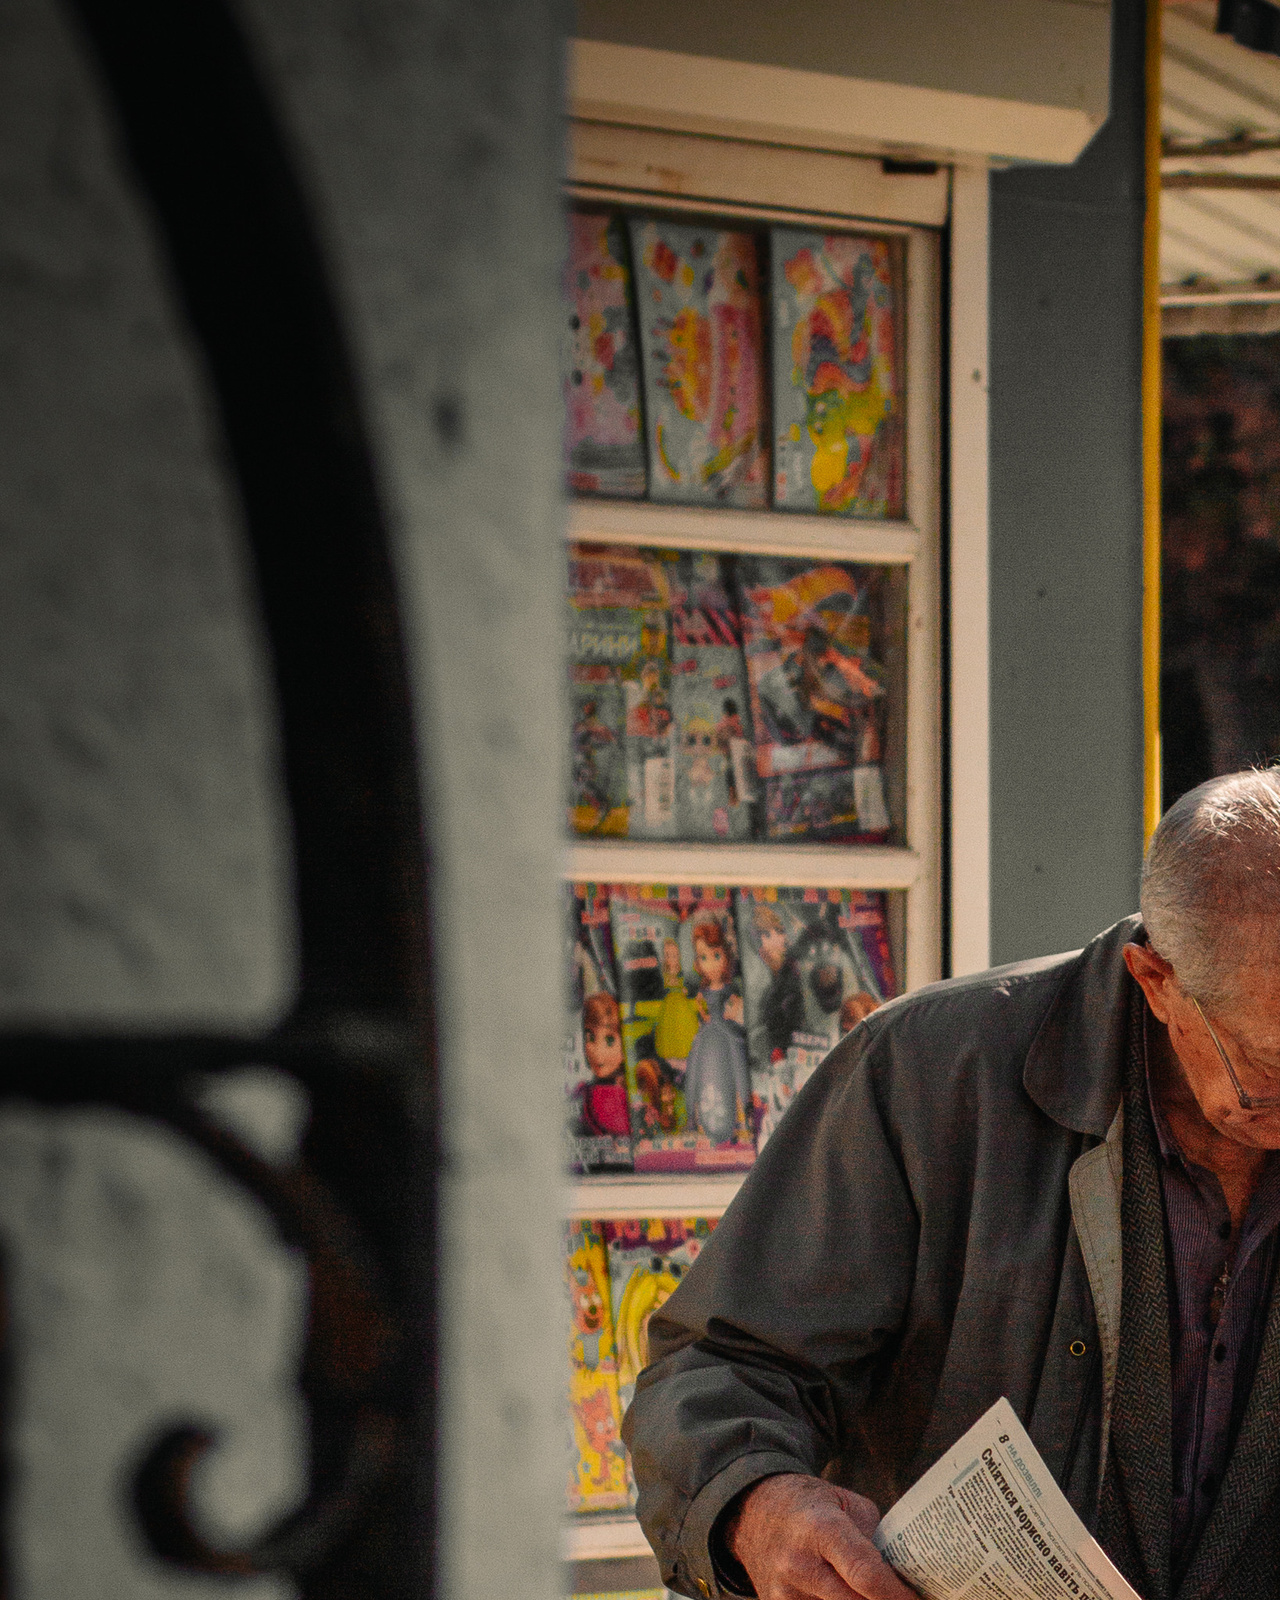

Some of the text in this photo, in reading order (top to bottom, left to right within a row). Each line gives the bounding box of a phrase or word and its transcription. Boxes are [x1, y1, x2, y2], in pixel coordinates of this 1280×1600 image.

[997, 1432, 1043, 1498] 8 НА ДОЗВІЛЛІ
[979, 1446, 1018, 1508] Сміятися
[1013, 1504, 1053, 1558] корисно
[1046, 1554, 1082, 1595] навіть
